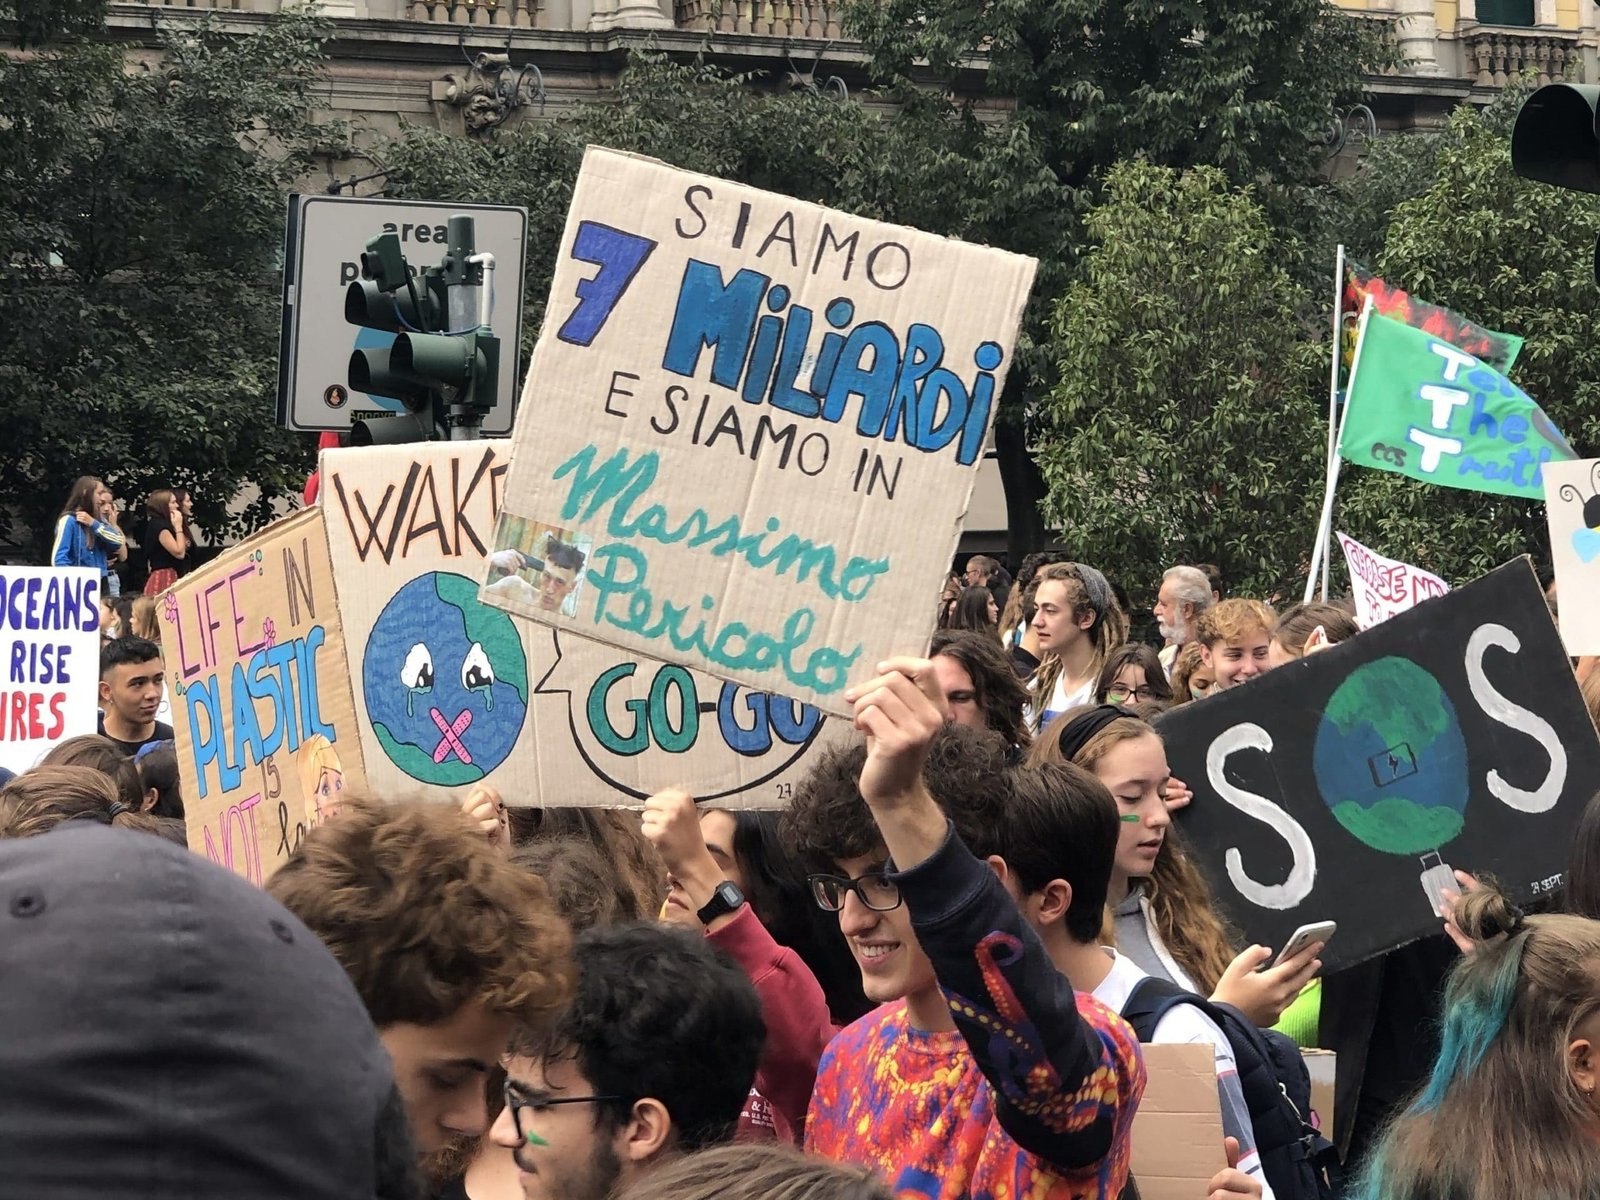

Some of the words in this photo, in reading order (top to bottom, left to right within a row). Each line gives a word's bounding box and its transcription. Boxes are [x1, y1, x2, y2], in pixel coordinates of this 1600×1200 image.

[557, 220, 658, 347] 7
[675, 185, 911, 291] SIAMO
[604, 371, 641, 418] E
[649, 385, 831, 477] SIAMO
[852, 448, 904, 501] IN
[1418, 383, 1529, 444] The
[552, 443, 889, 603] Massimo
[10, 640, 72, 684] RISE
[174, 565, 267, 679] LIFE
[282, 537, 315, 627] IN
[587, 542, 863, 697] Pericolo
[185, 624, 337, 799] PLASTIC
[260, 755, 282, 801] IS
